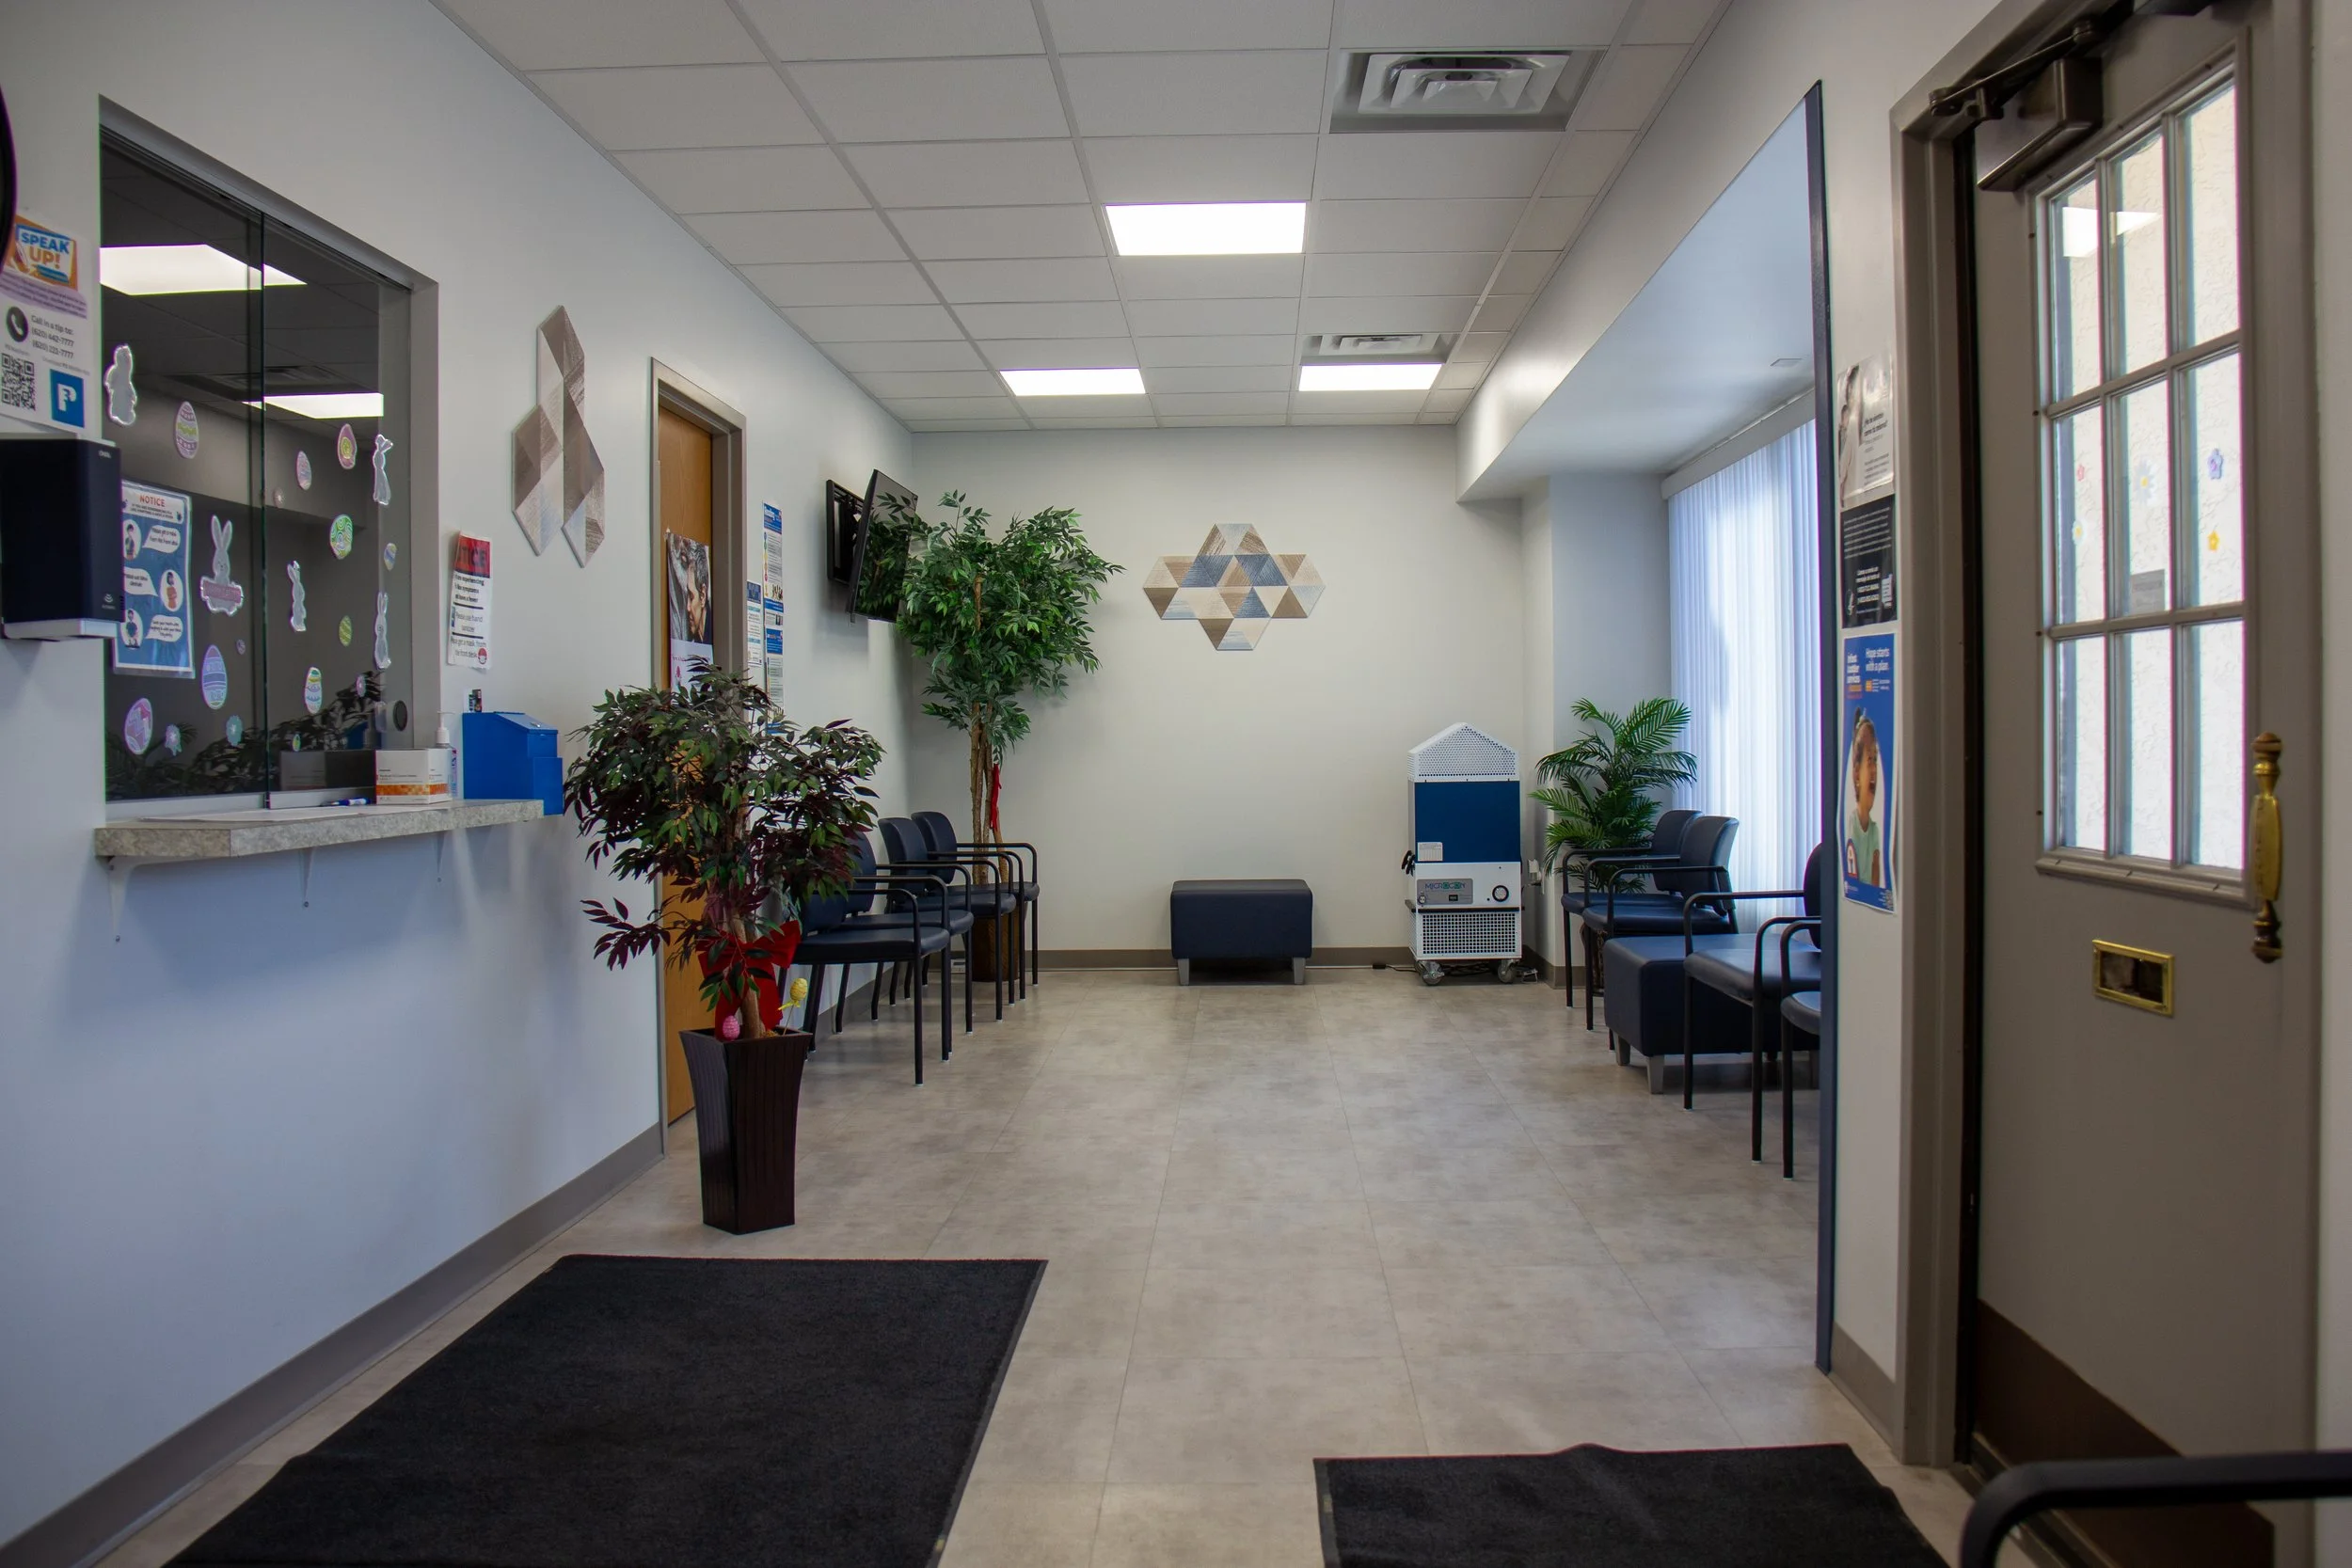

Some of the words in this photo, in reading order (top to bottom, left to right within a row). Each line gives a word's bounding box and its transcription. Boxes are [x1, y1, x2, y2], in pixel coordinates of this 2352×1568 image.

[22, 232, 70, 254] SPEAK
[29, 246, 60, 269] UP!
[31, 314, 42, 325] Call
[44, 319, 50, 328] in
[55, 324, 64, 333] tip
[65, 326, 74, 336] to:
[32, 326, 47, 339] (620)
[48, 333, 74, 347] 442-7777
[33, 339, 48, 352] (620)
[139, 494, 166, 507] NOTICE
